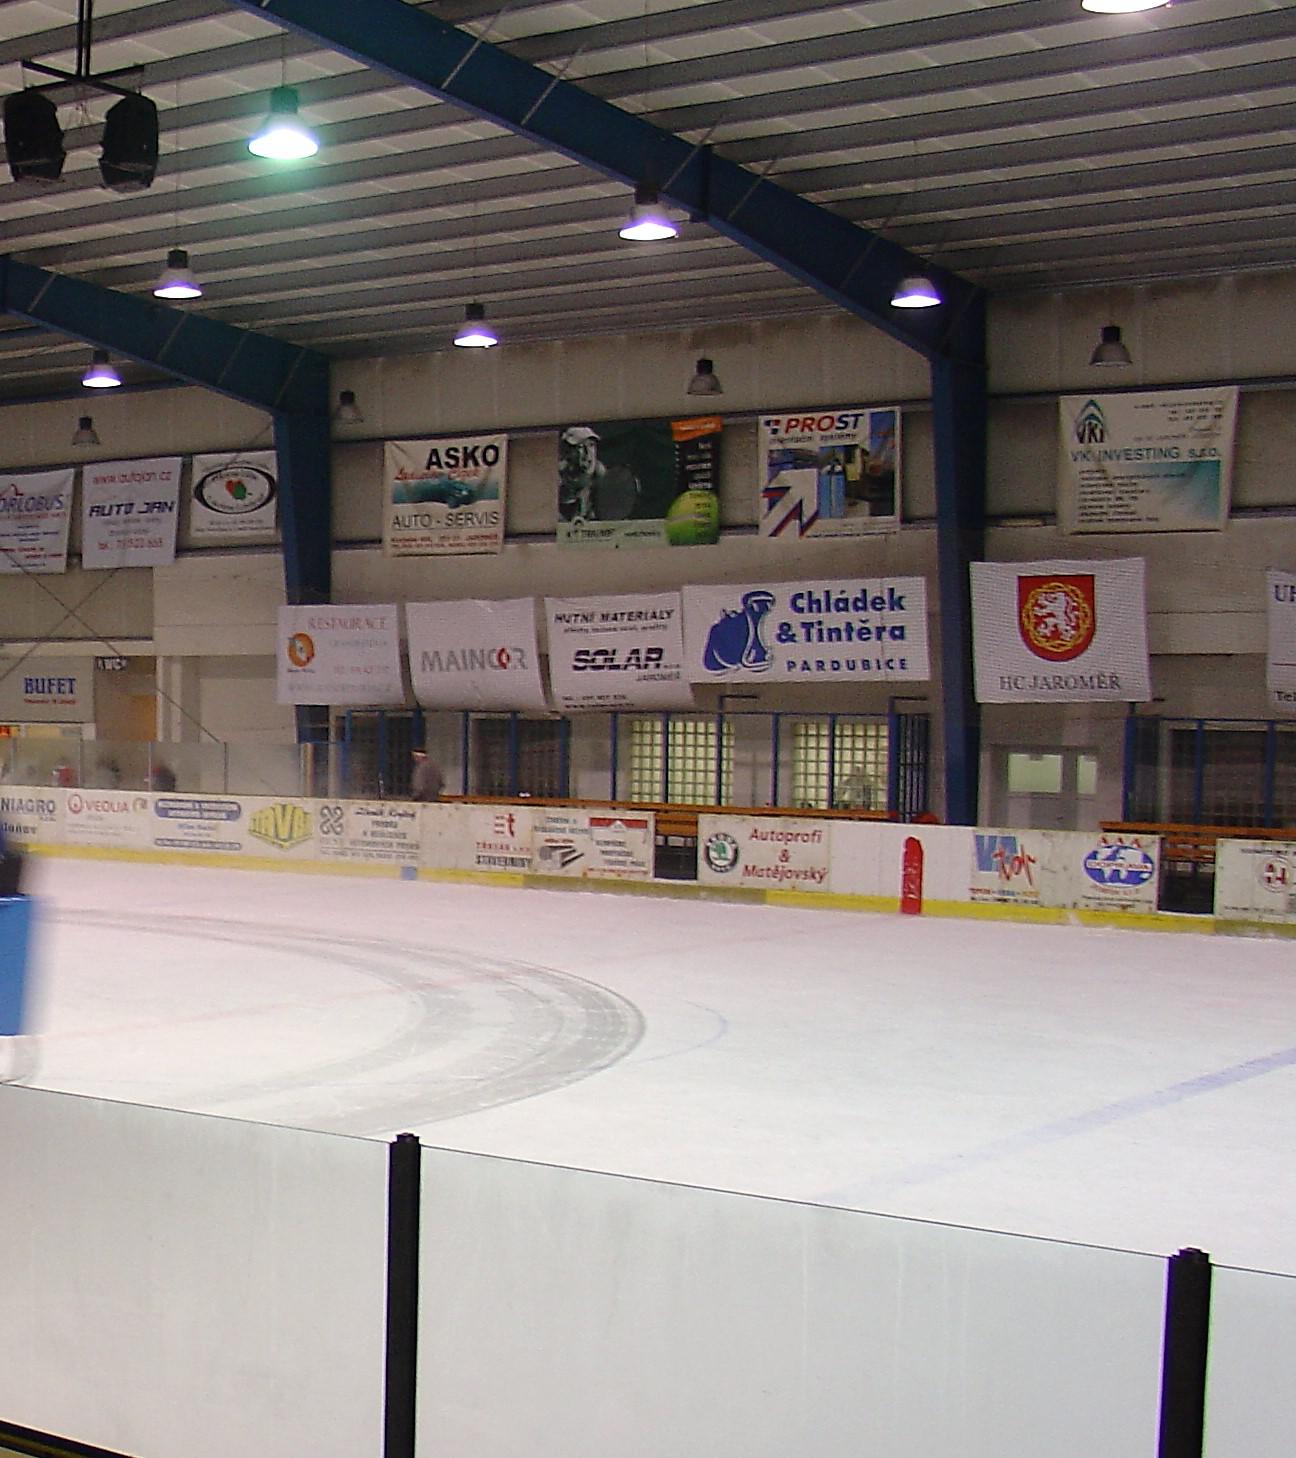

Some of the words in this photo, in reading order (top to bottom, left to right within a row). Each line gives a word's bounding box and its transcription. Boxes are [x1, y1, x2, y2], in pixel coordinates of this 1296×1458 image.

[785, 413, 864, 434] PROST
[425, 444, 500, 470] ASKO
[1097, 447, 1180, 462] INVESTING
[89, 502, 135, 518] AUTO
[136, 500, 177, 515] JAN
[392, 513, 433, 530] AUTO
[444, 511, 500, 528] SERVIS
[789, 587, 906, 615] Chládek
[776, 622, 797, 645] &
[800, 618, 906, 644] Tintěra
[420, 647, 529, 673] MAINCOR
[572, 646, 665, 672] SOLAR
[786, 657, 909, 673] PARDUBICE
[24, 677, 77, 695] BUFET
[1000, 675, 1025, 692] HC
[1027, 671, 1122, 691] JAROMĚŘ
[84, 799, 129, 814] VEOLIA
[749, 827, 823, 845] Autoprofi
[778, 848, 791, 863] &
[742, 864, 828, 885] Matějovský
